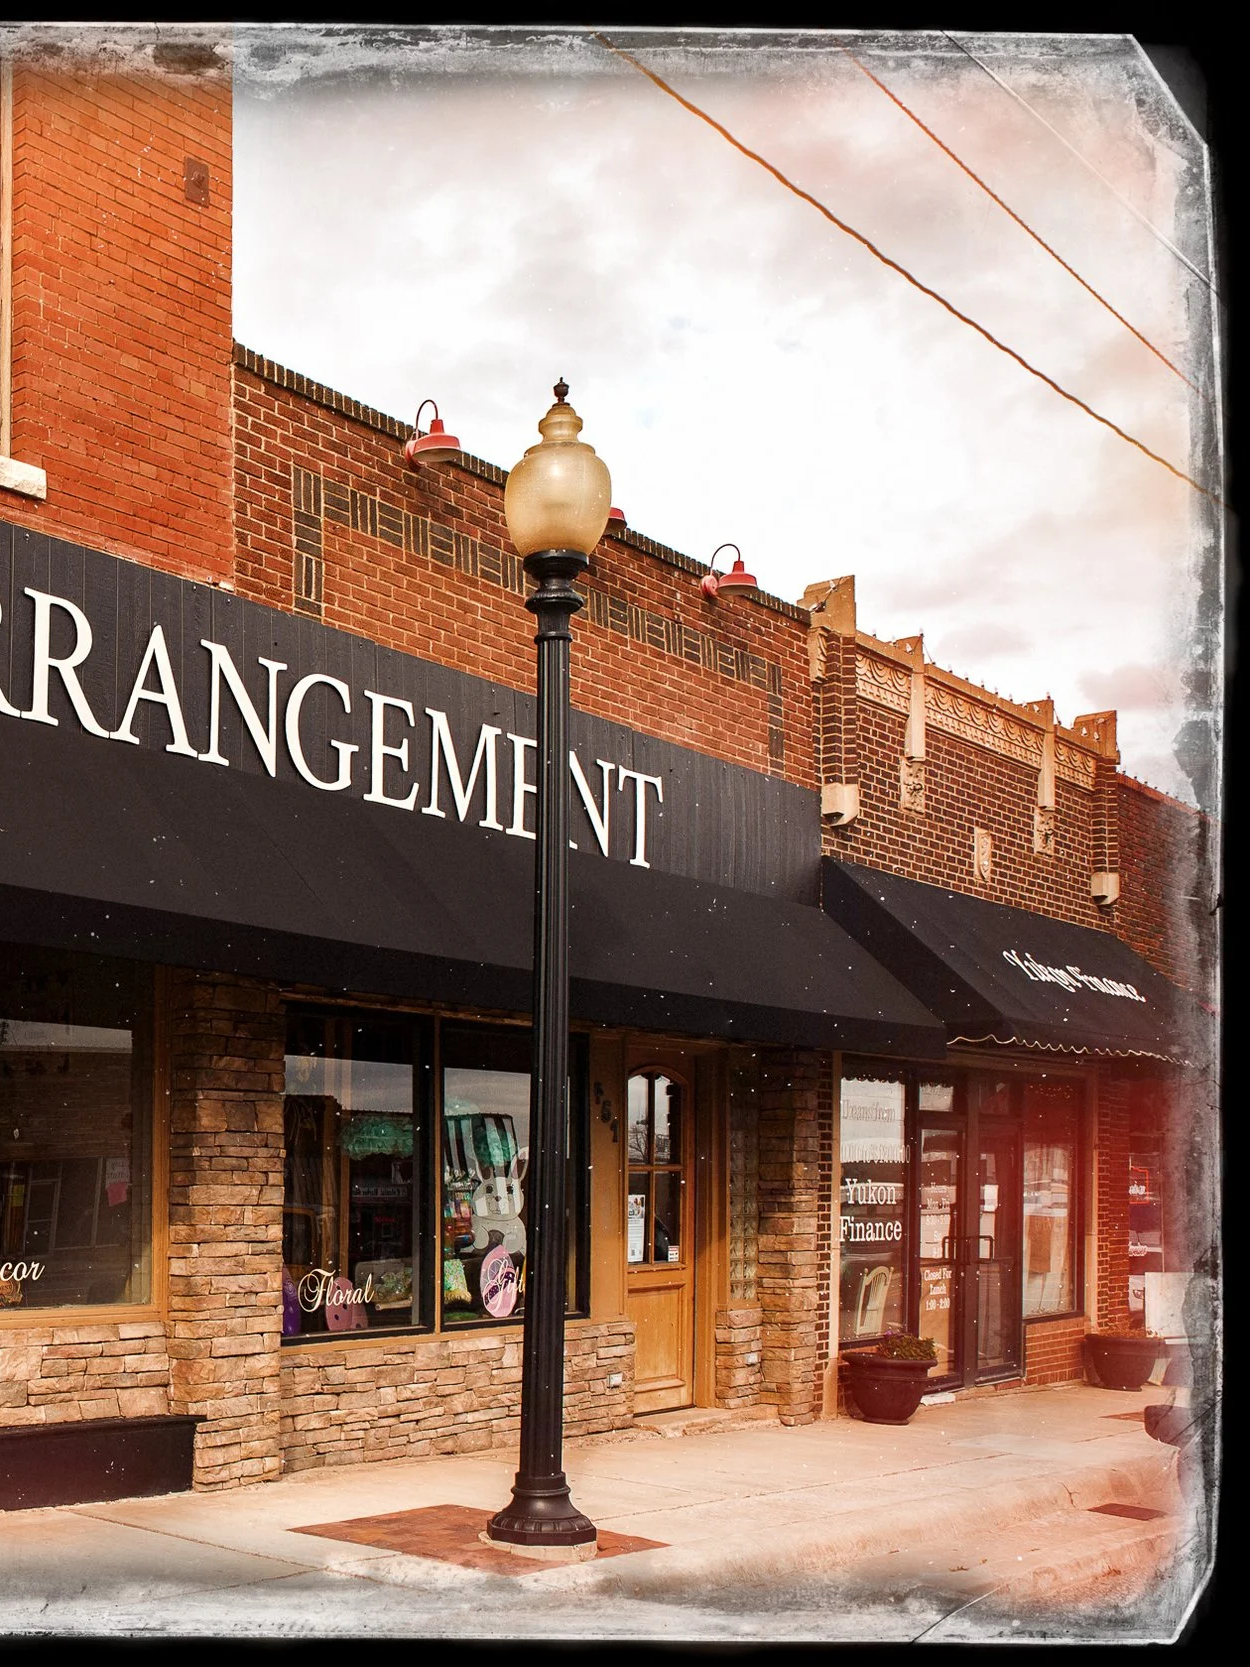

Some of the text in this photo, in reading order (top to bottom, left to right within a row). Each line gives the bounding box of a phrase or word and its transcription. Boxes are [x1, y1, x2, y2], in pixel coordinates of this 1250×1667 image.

[1003, 950, 1146, 1002] Yukon Finance
[845, 1177, 897, 1205] Yukon
[839, 1216, 902, 1242] Finance
[924, 1269, 942, 1281] Closed
[298, 1268, 375, 1312] Floral
[929, 1283, 946, 1295] Lunch
